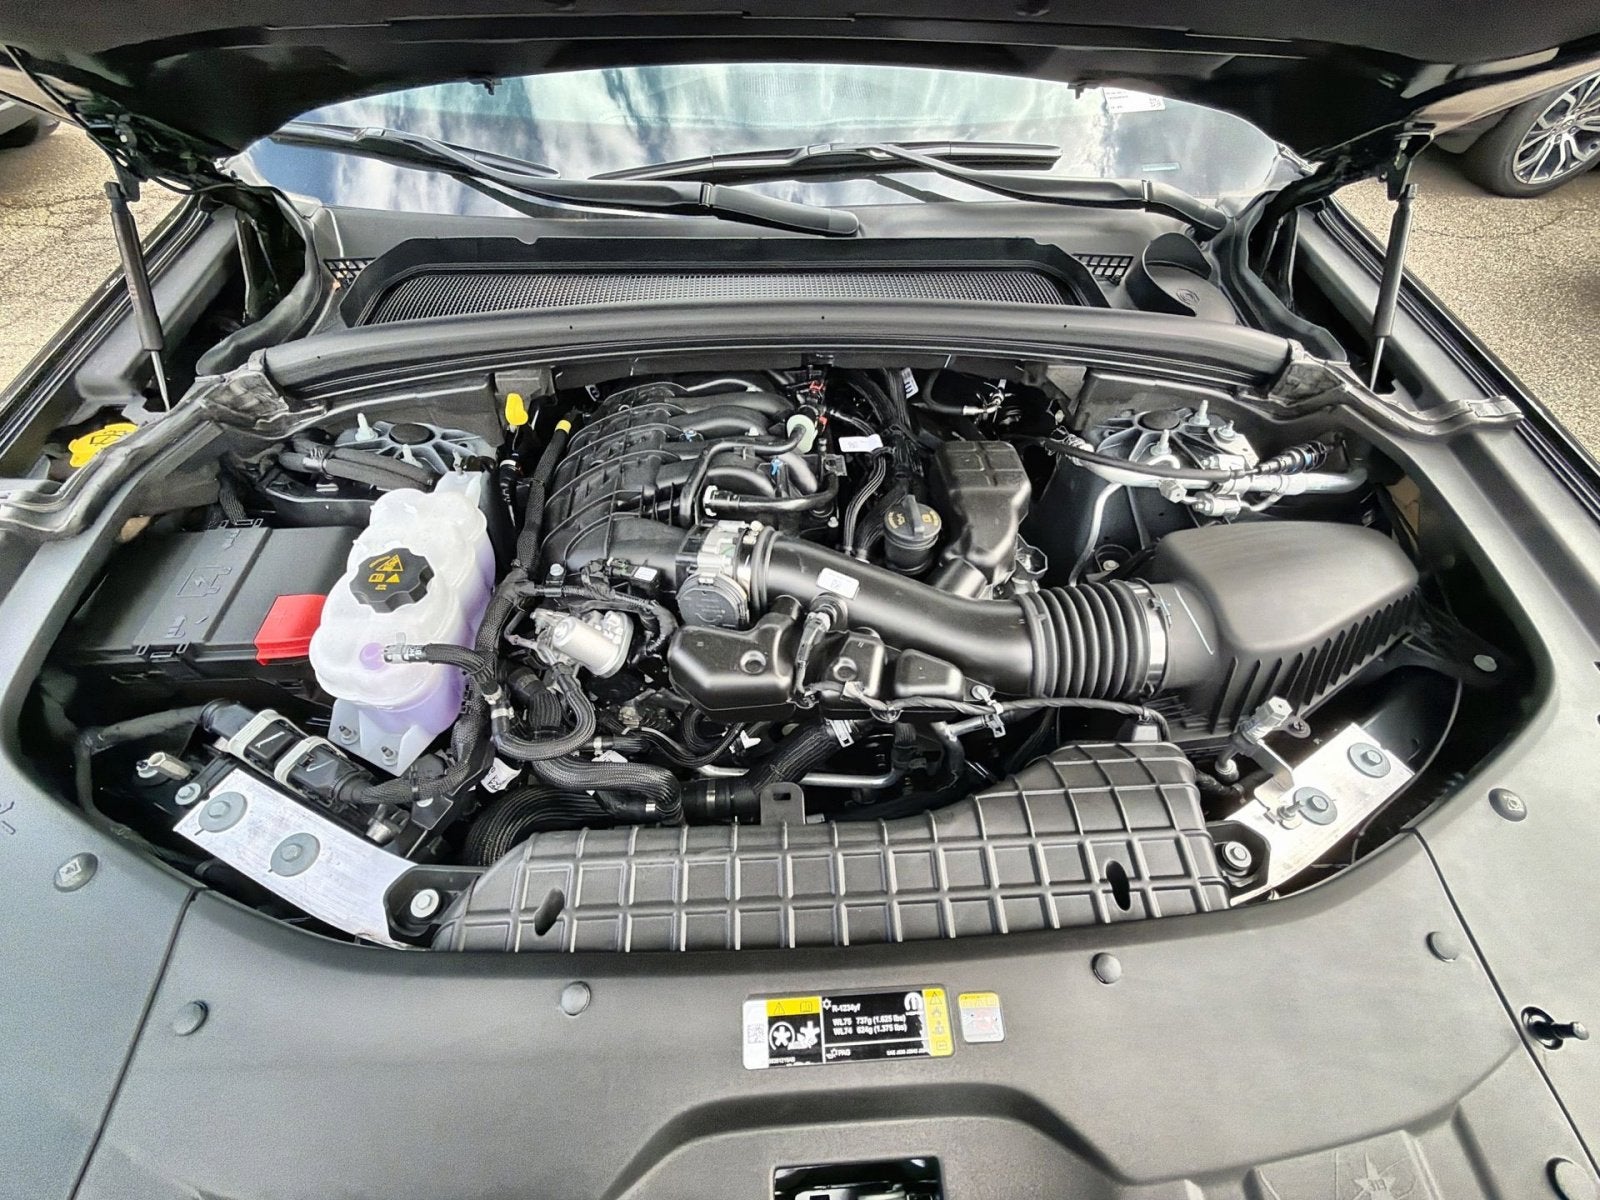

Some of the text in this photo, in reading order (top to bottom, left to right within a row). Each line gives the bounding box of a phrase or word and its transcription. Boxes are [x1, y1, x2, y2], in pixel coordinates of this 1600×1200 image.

[832, 1017, 852, 1026] WL75
[855, 1016, 873, 1026] 737g
[833, 1027, 853, 1036] WL74
